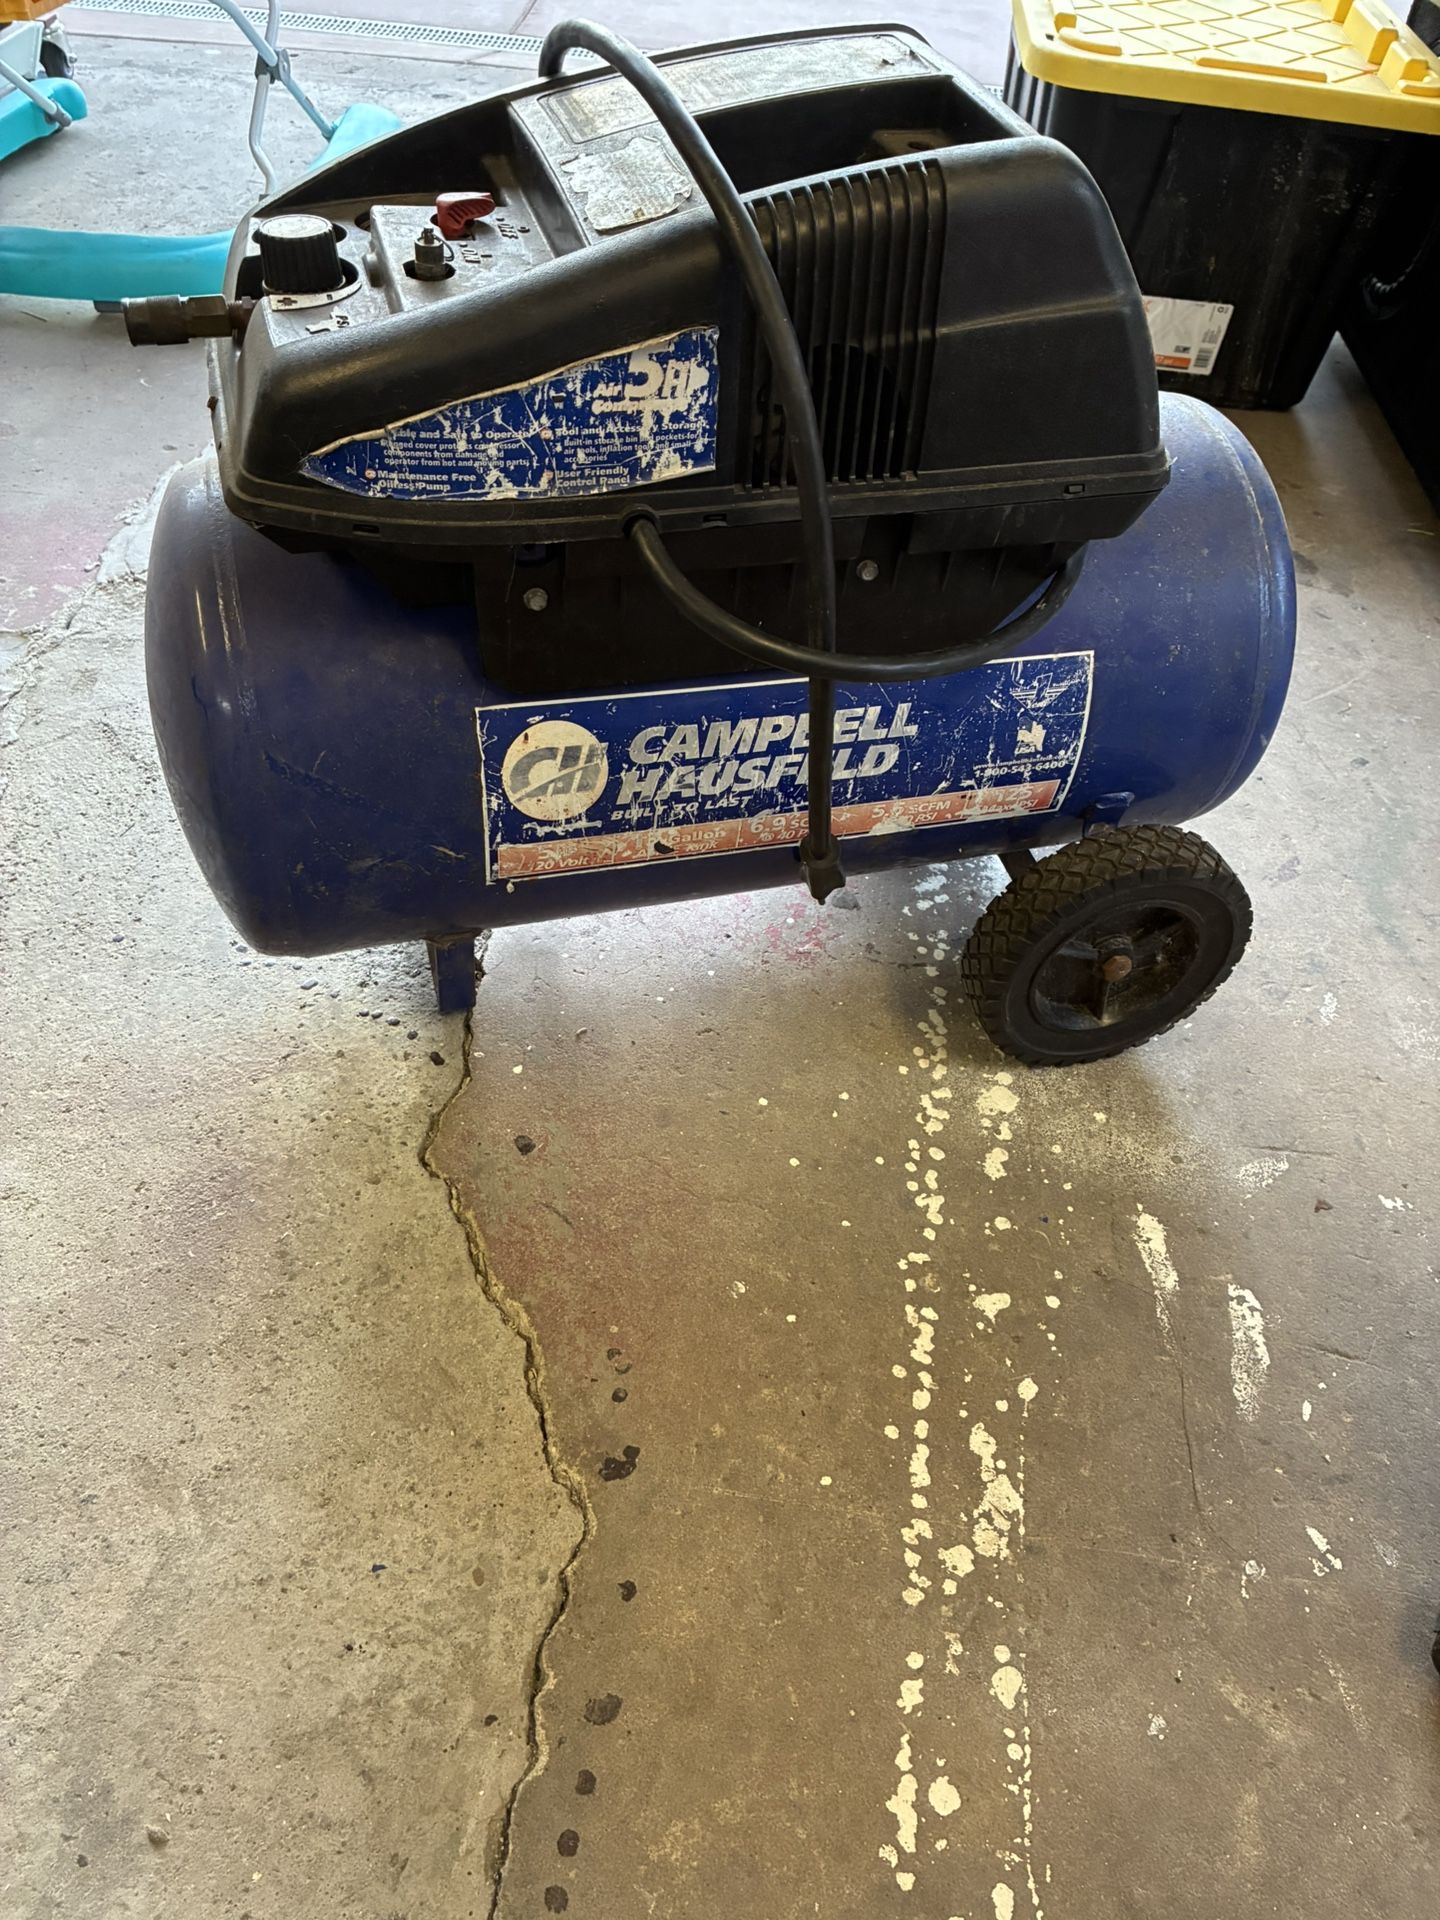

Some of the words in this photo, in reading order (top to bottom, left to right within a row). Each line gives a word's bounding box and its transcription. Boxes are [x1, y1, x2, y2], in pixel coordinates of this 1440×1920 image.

[420, 430, 440, 439] and
[555, 427, 579, 436] Tool
[626, 435, 638, 443] bin
[383, 449, 432, 458] components
[434, 450, 453, 458] from
[600, 444, 633, 452] inflation
[384, 458, 419, 467] operator
[421, 458, 440, 466] from
[442, 459, 456, 467] hot
[458, 459, 474, 467] and
[377, 470, 449, 481] Maintenance
[451, 473, 477, 482] Free
[556, 470, 581, 478] User
[584, 466, 629, 476] Friendly
[556, 477, 596, 487] Control
[600, 475, 630, 485] Panel
[418, 482, 451, 492] Pump
[610, 804, 669, 821] BUILT
[704, 796, 752, 810] LAST
[750, 816, 786, 833] 6.9
[672, 830, 726, 842] Gallon
[558, 854, 590, 868] Volt
